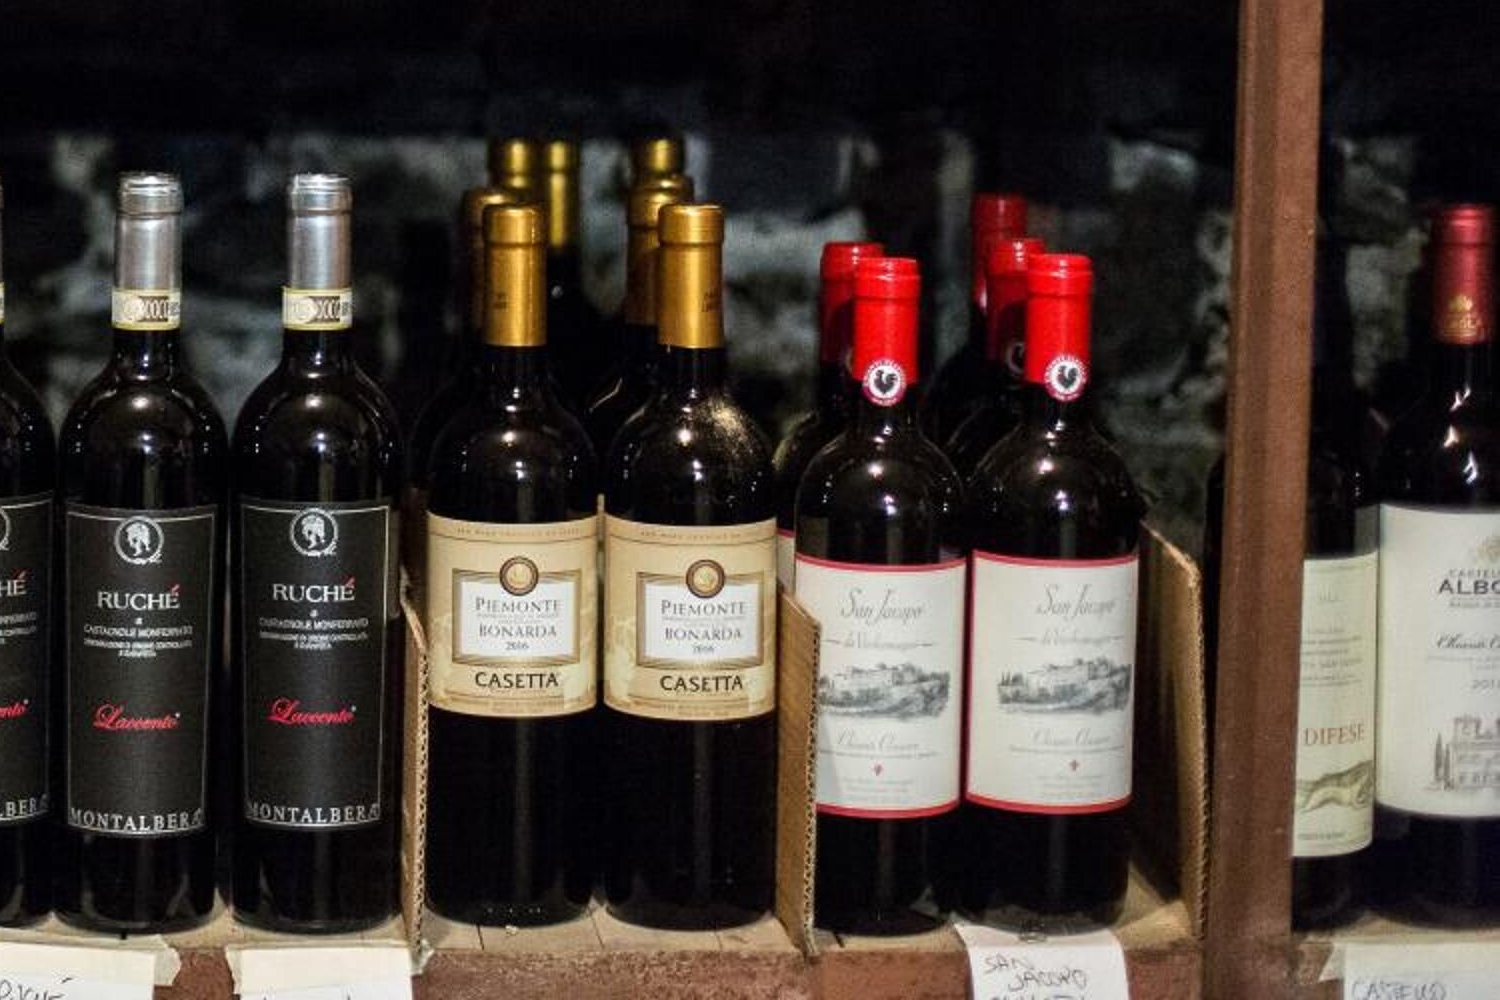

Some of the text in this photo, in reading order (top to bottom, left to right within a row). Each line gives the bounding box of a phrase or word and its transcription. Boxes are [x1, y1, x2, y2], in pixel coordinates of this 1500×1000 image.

[96, 583, 181, 612] RUCHÉ
[272, 576, 356, 604] RUCHÉ
[475, 596, 558, 614] PIEMONTE
[660, 599, 747, 617] PIEMONTE
[479, 623, 558, 639] BONARDA
[664, 627, 743, 642] BONARDA
[474, 671, 560, 689] CASETTA
[659, 675, 744, 693] CASETTA
[68, 807, 204, 832] MONTALBERA
[249, 802, 381, 825] MONTALBERA
